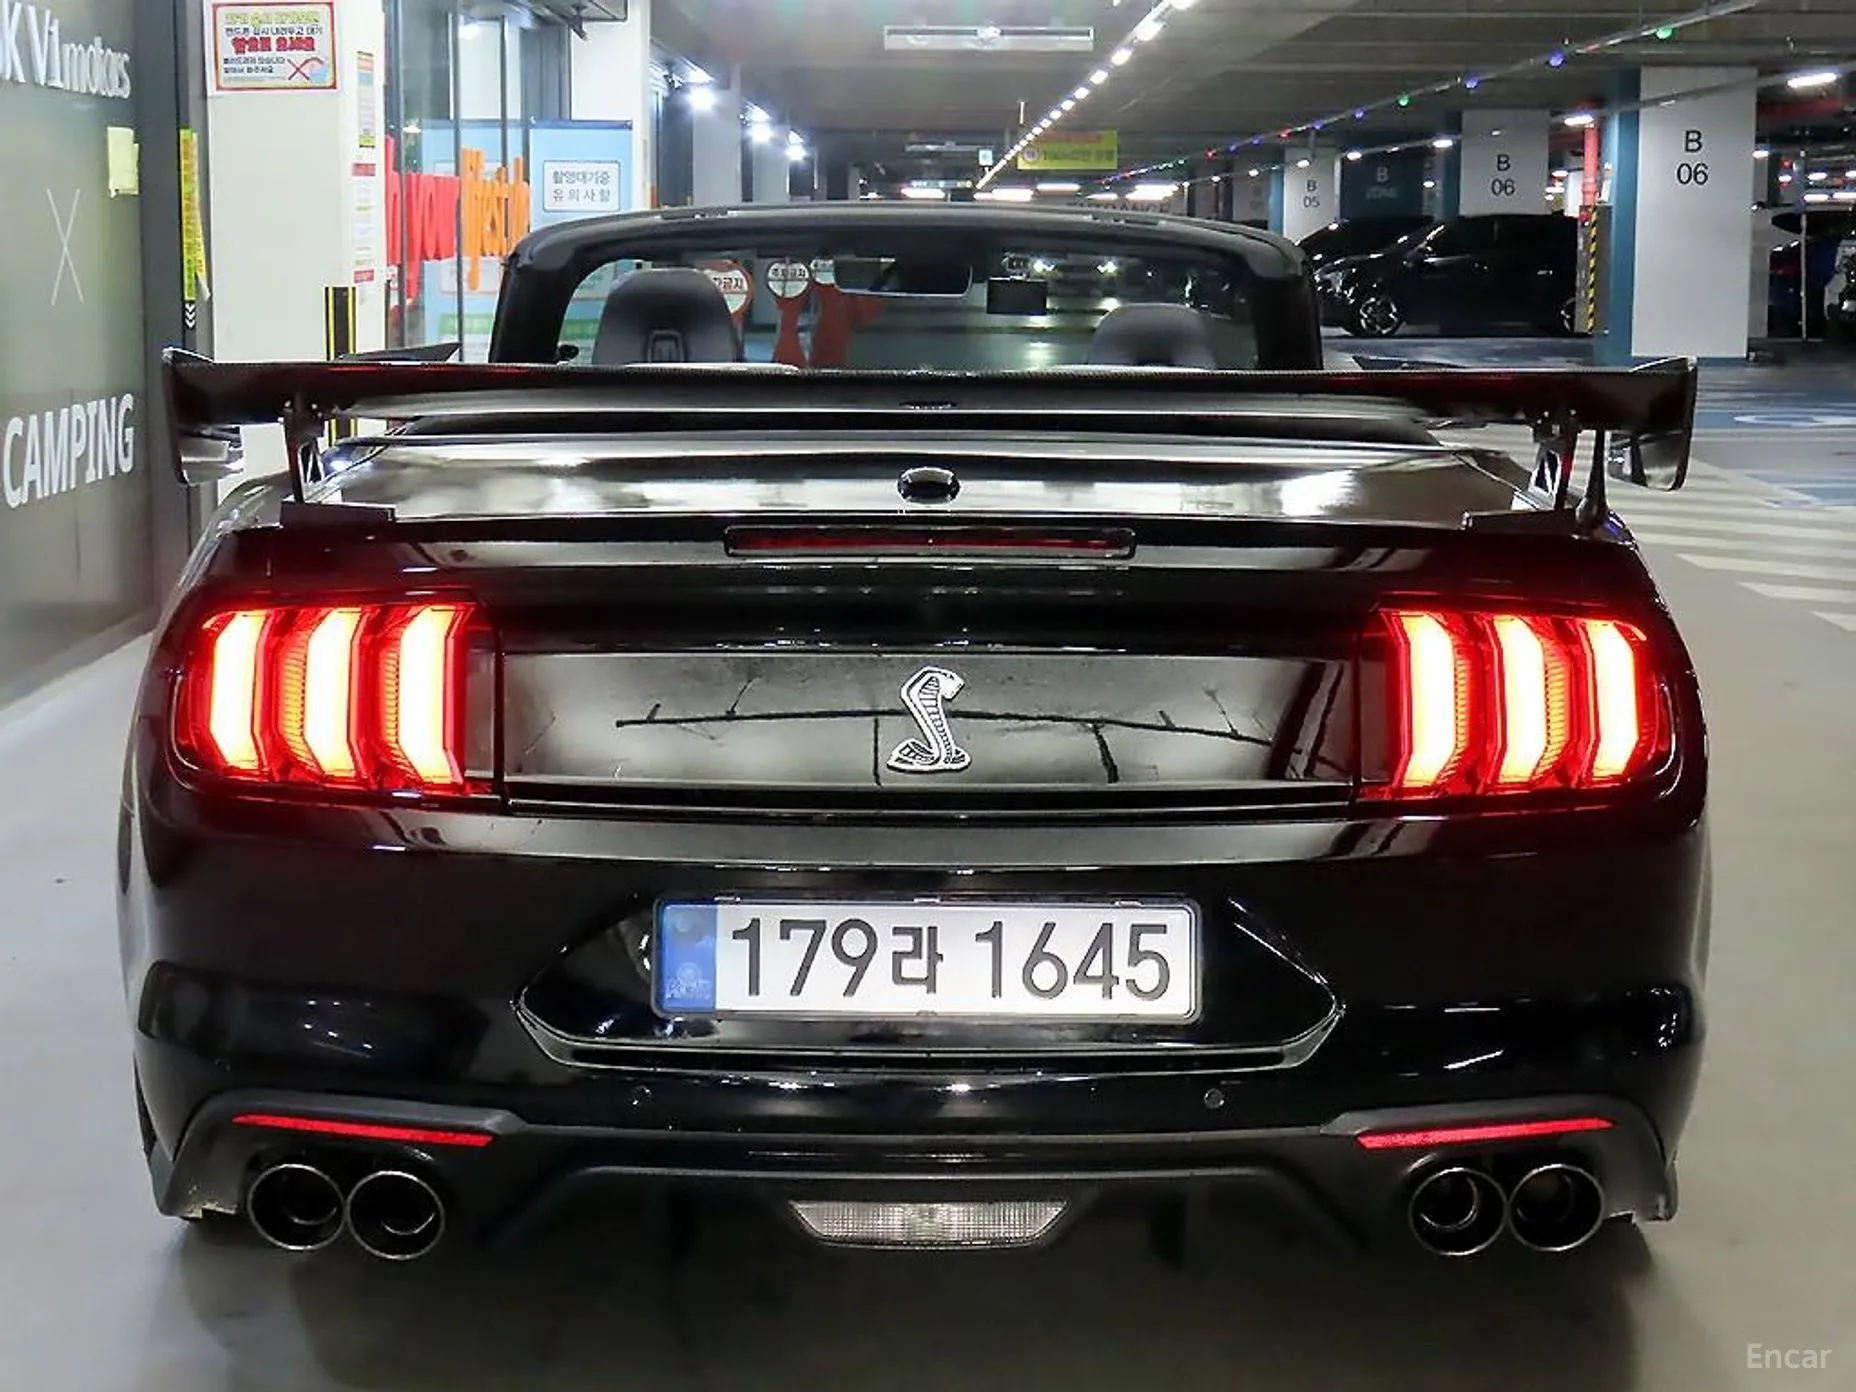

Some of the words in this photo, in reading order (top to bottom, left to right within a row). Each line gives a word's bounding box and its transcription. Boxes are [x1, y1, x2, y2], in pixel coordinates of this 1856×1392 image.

[1684, 129, 1703, 152] B
[1496, 154, 1511, 172] B
[1676, 163, 1709, 186] 06
[1306, 179, 1317, 192] B
[1491, 179, 1515, 197] 06
[1303, 196, 1321, 208] 05
[3, 393, 135, 509] CAMPING
[732, 918, 944, 998] 179라
[975, 921, 1171, 1001] 1645
